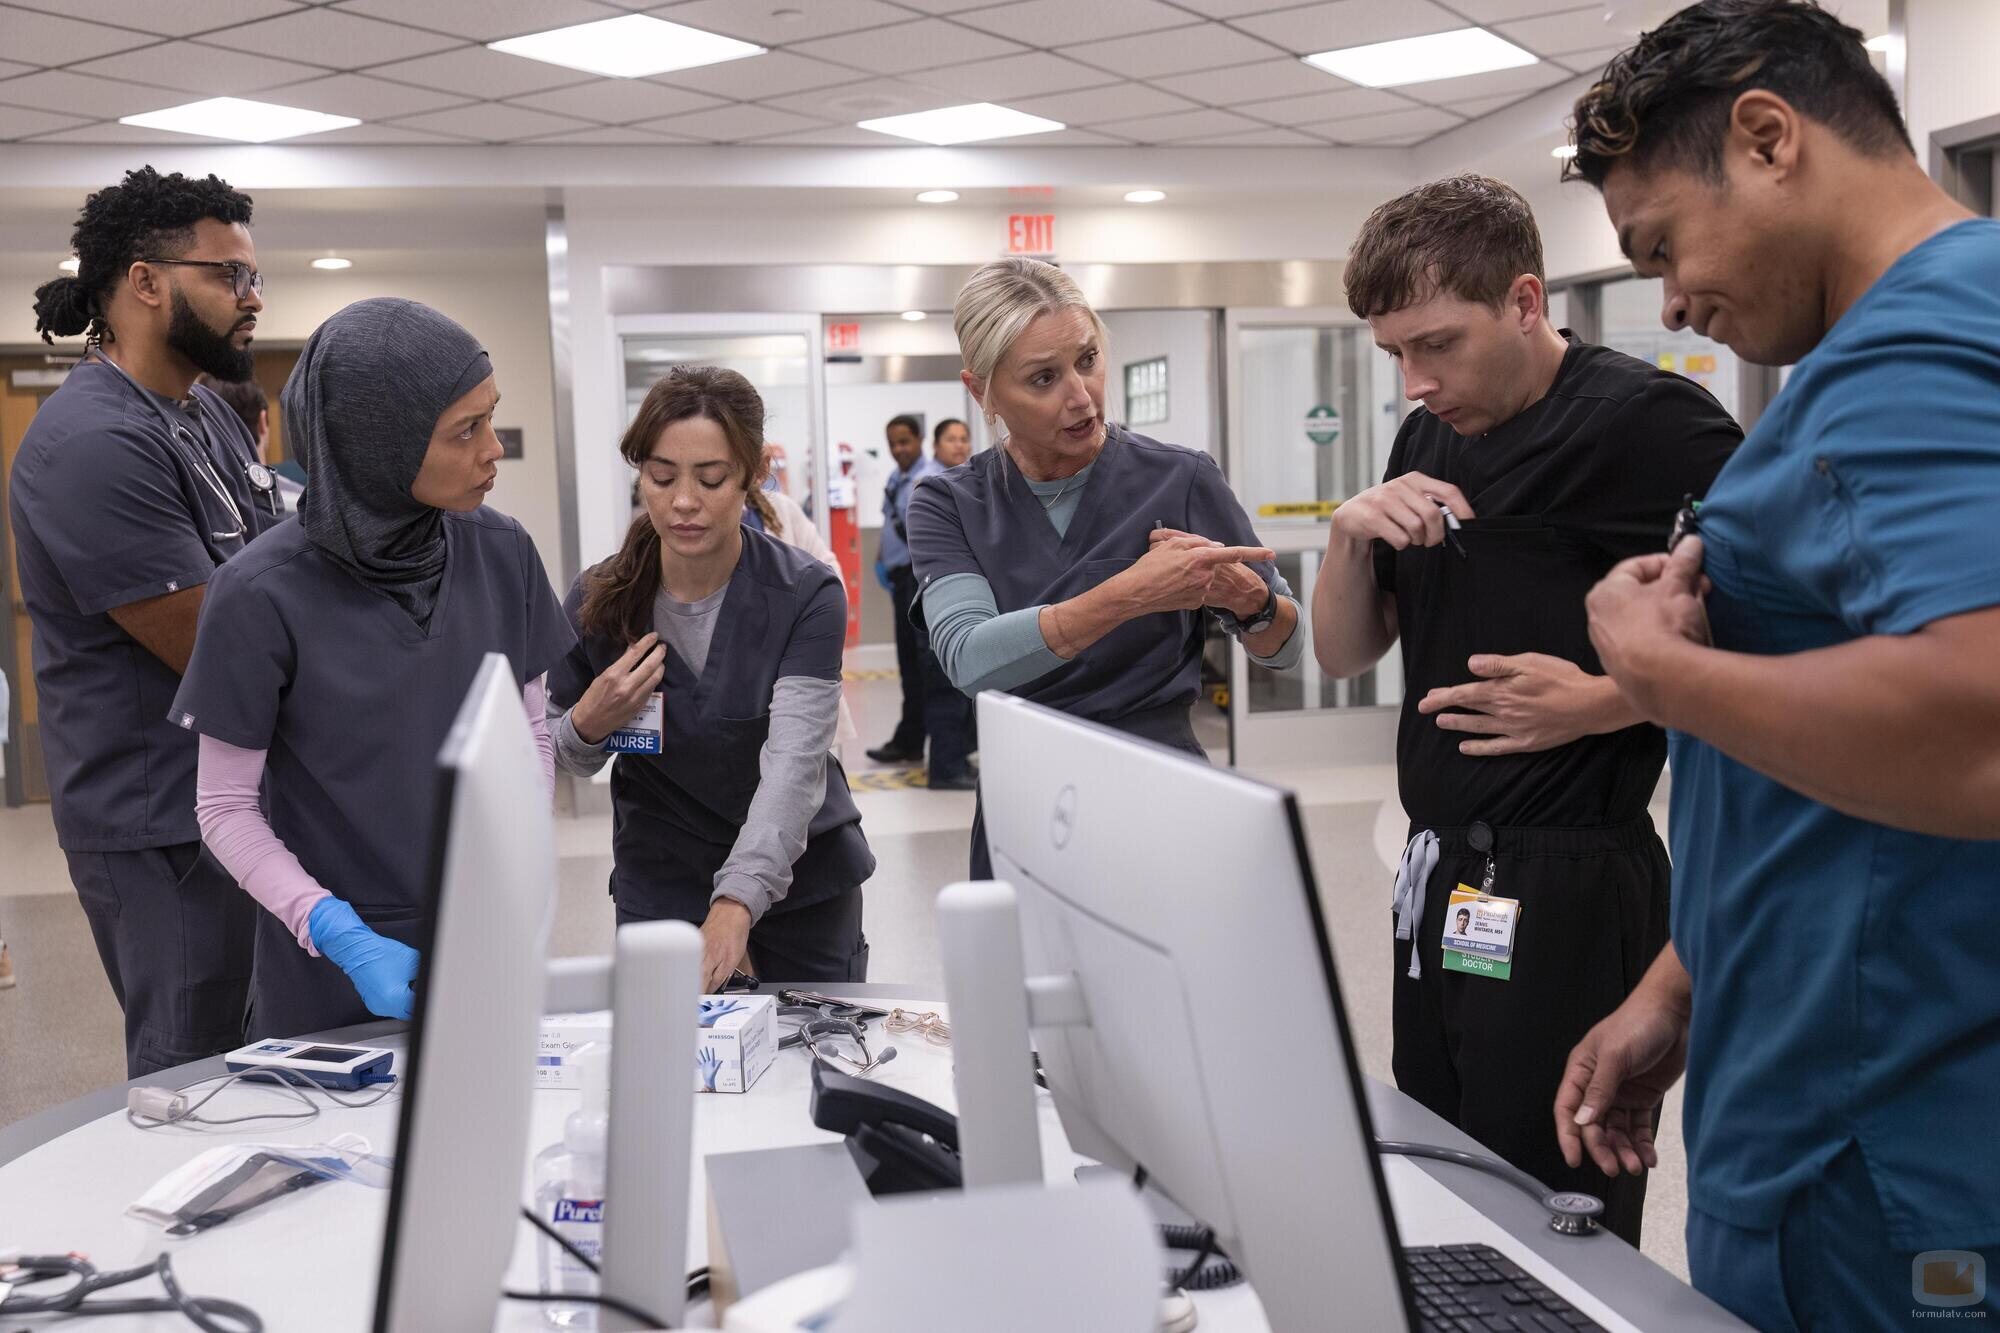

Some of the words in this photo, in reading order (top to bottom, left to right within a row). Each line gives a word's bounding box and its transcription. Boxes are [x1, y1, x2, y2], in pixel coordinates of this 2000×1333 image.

[1008, 214, 1055, 252] EXIT
[610, 735, 654, 750] NURSE
[1453, 939, 1470, 949] SCHOOL
[1476, 943, 1497, 951] MEDICINE
[1462, 958, 1493, 972] DOCTOR
[541, 1041, 561, 1049] Exam
[559, 1200, 604, 1220] Purel
